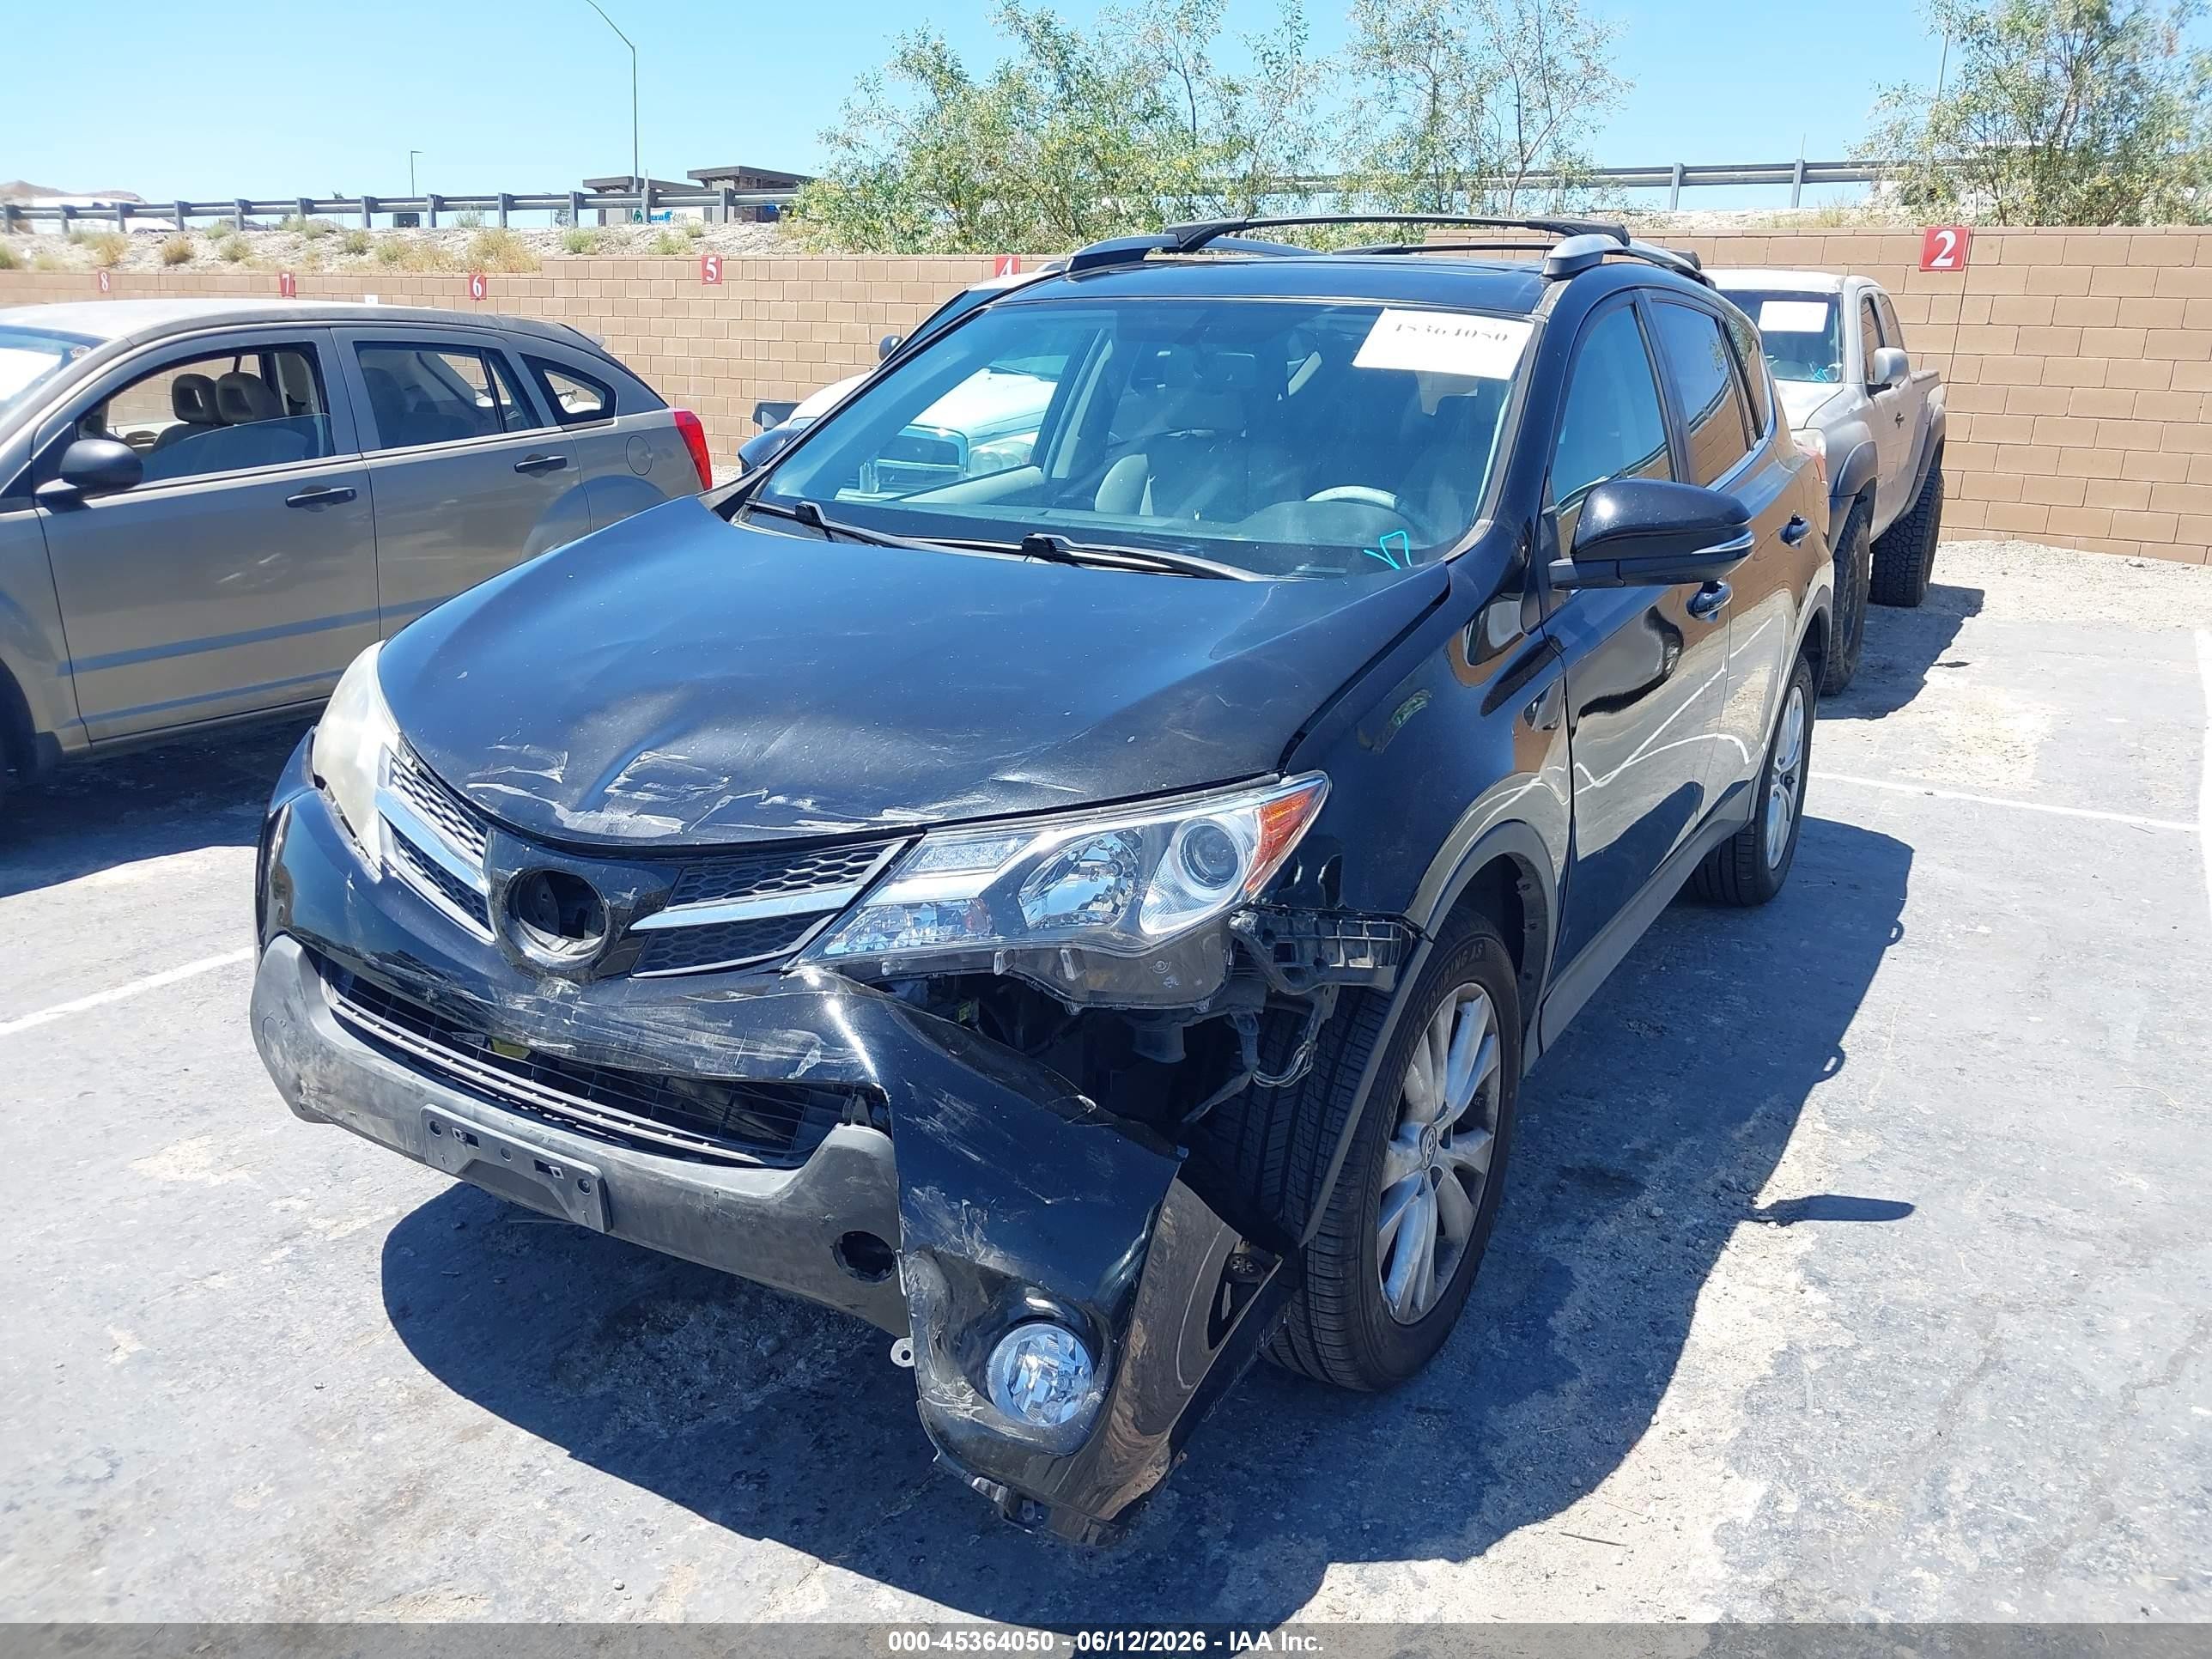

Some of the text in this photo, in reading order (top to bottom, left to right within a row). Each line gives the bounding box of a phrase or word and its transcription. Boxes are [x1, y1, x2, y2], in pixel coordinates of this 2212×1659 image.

[1929, 229, 1956, 267] 2
[706, 257, 717, 282] 5
[999, 258, 1012, 276] 4
[100, 271, 109, 291] 8
[282, 273, 290, 295] 7
[472, 275, 483, 297] 6
[1422, 949, 1468, 1022] TOURING
[1468, 942, 1484, 963] AS
